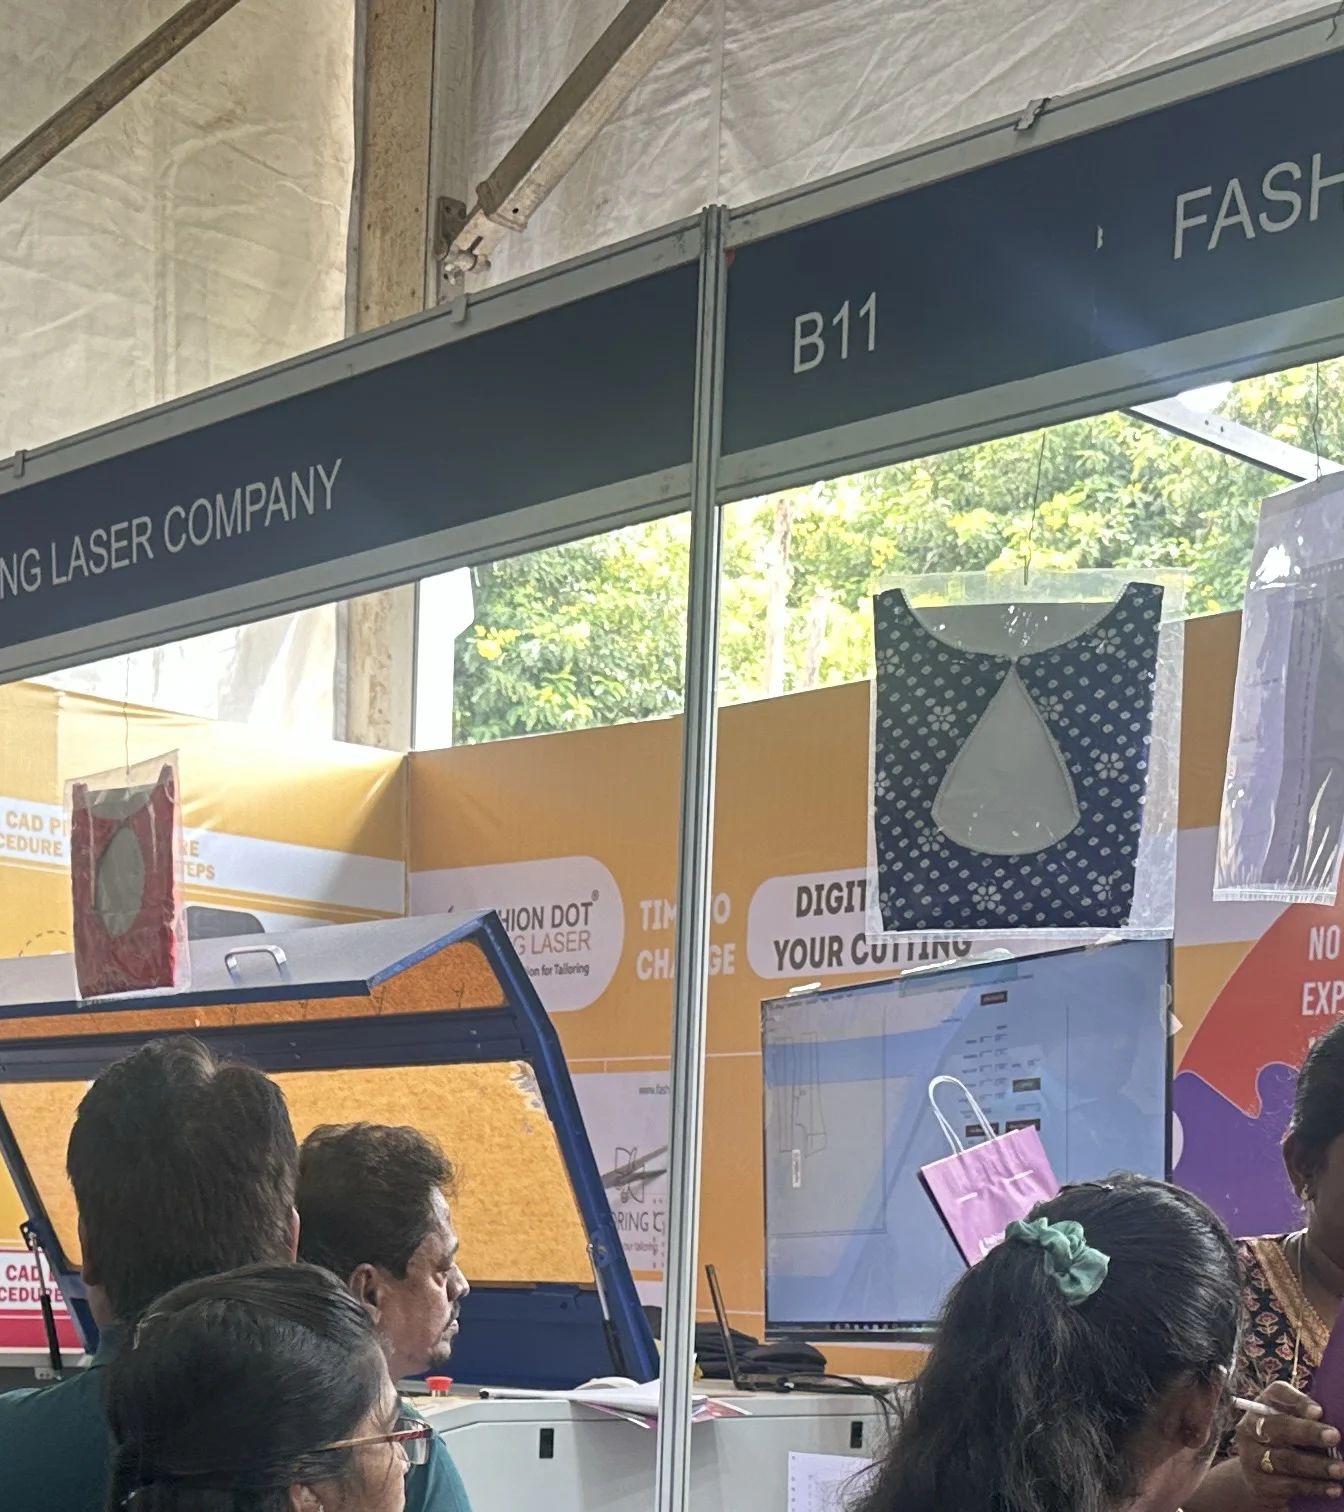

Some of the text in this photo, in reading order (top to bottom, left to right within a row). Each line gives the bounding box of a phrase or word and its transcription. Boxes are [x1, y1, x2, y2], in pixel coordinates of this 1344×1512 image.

[794, 291, 876, 374] B11
[51, 516, 154, 585] LASER
[164, 458, 342, 553] COMPANY
[6, 810, 44, 832] CAD
[640, 898, 677, 931] TIM
[796, 879, 866, 918] DIGIT
[498, 905, 544, 932] HION
[531, 930, 591, 955] LASER
[773, 935, 843, 971] YOUR
[1309, 924, 1341, 960] NO
